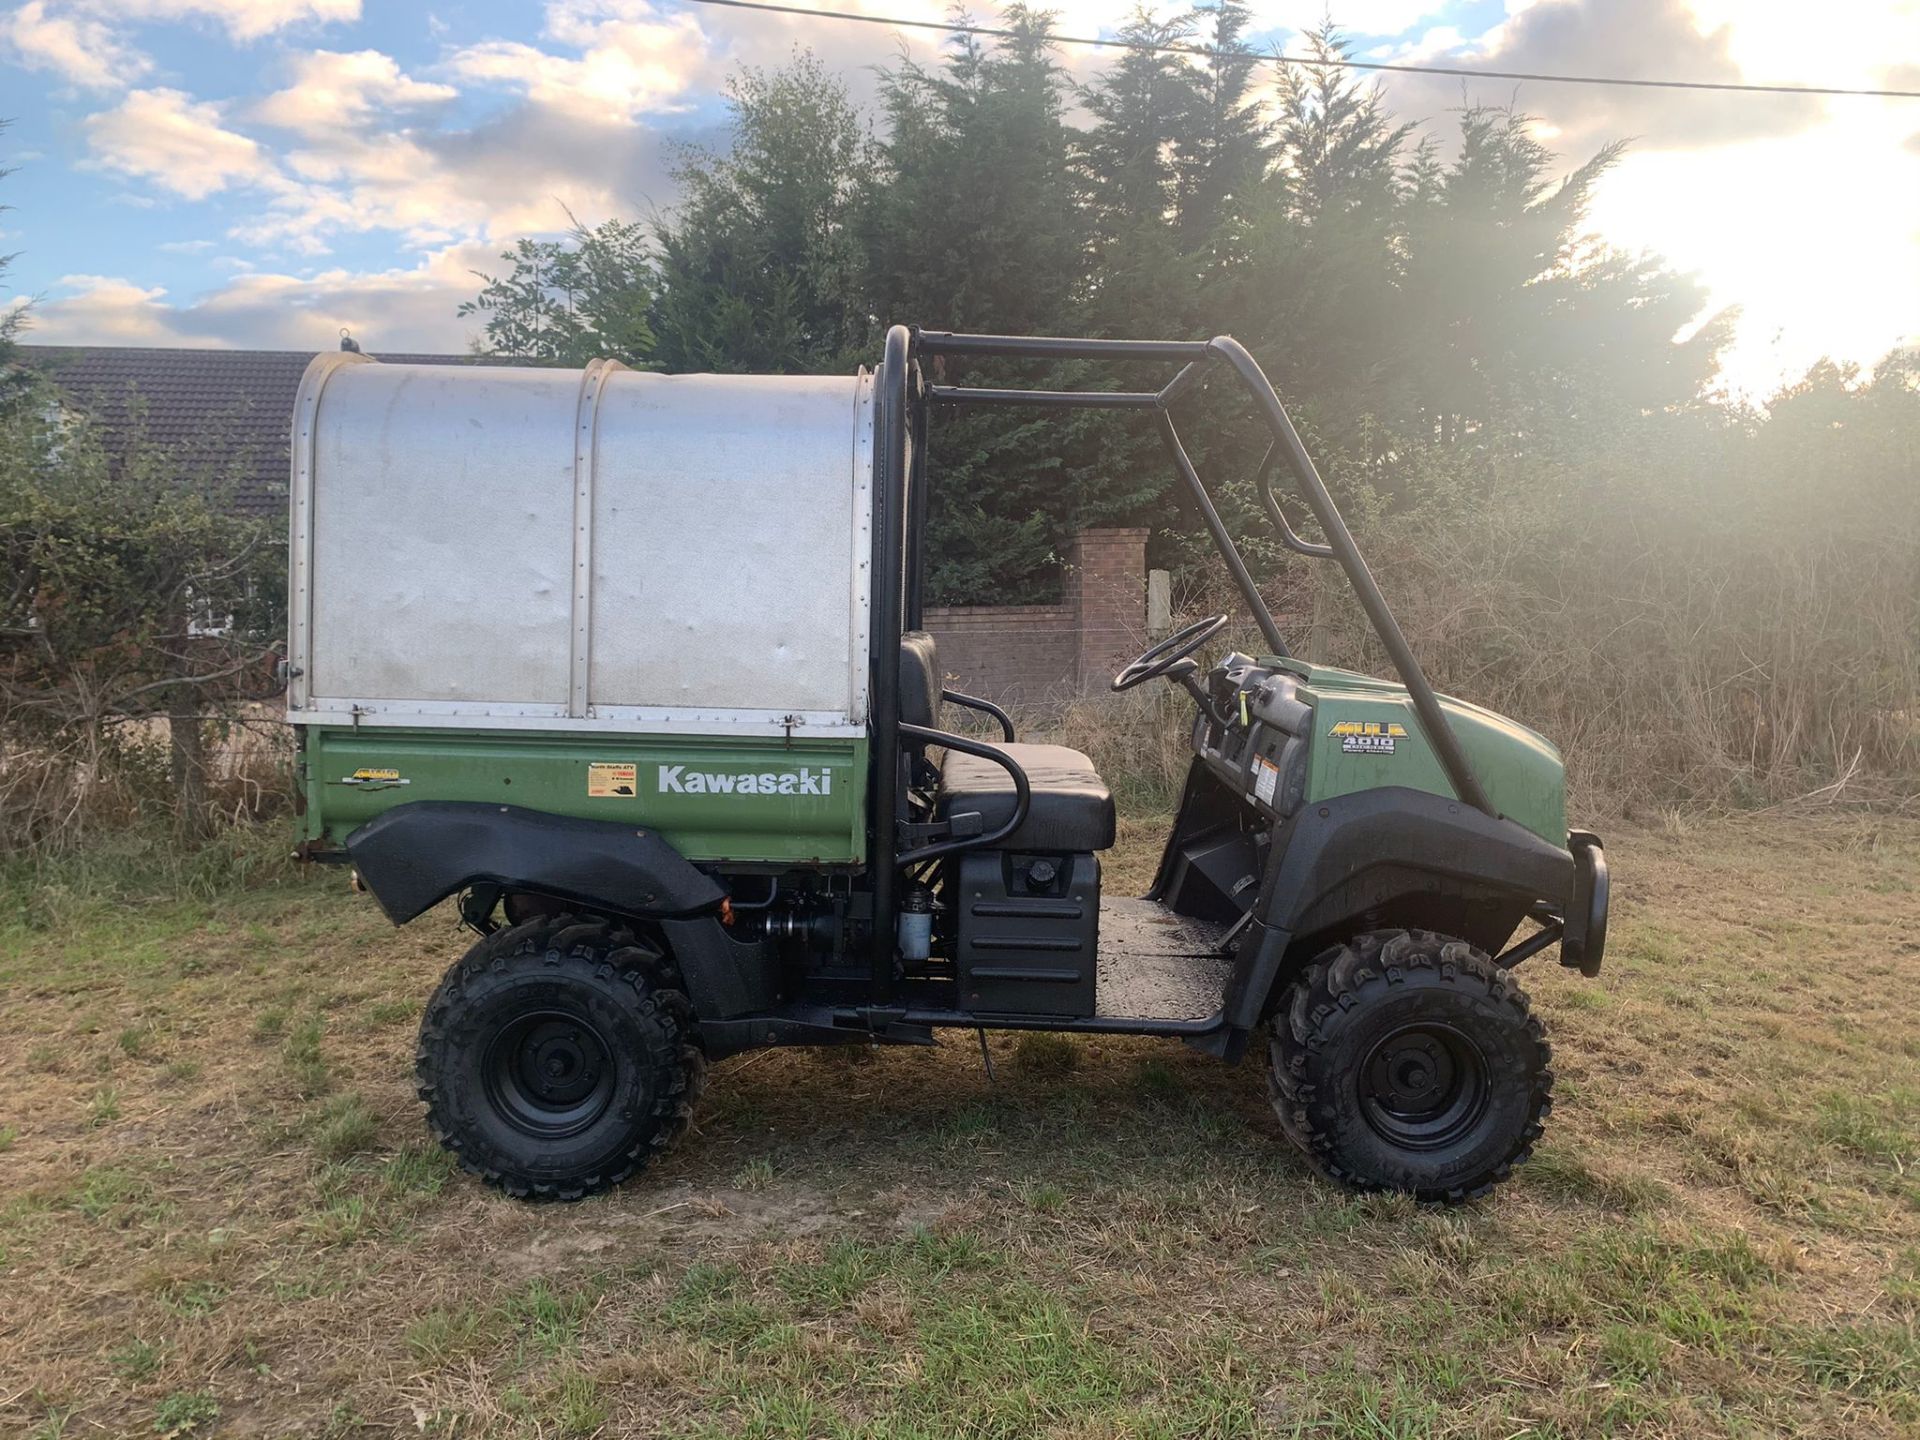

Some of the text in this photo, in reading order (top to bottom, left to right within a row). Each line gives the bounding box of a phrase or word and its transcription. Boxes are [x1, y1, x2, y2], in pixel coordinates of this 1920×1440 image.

[1328, 721, 1409, 739] MULE
[1343, 738, 1394, 746] 4010
[658, 765, 831, 795] Kawasaki
